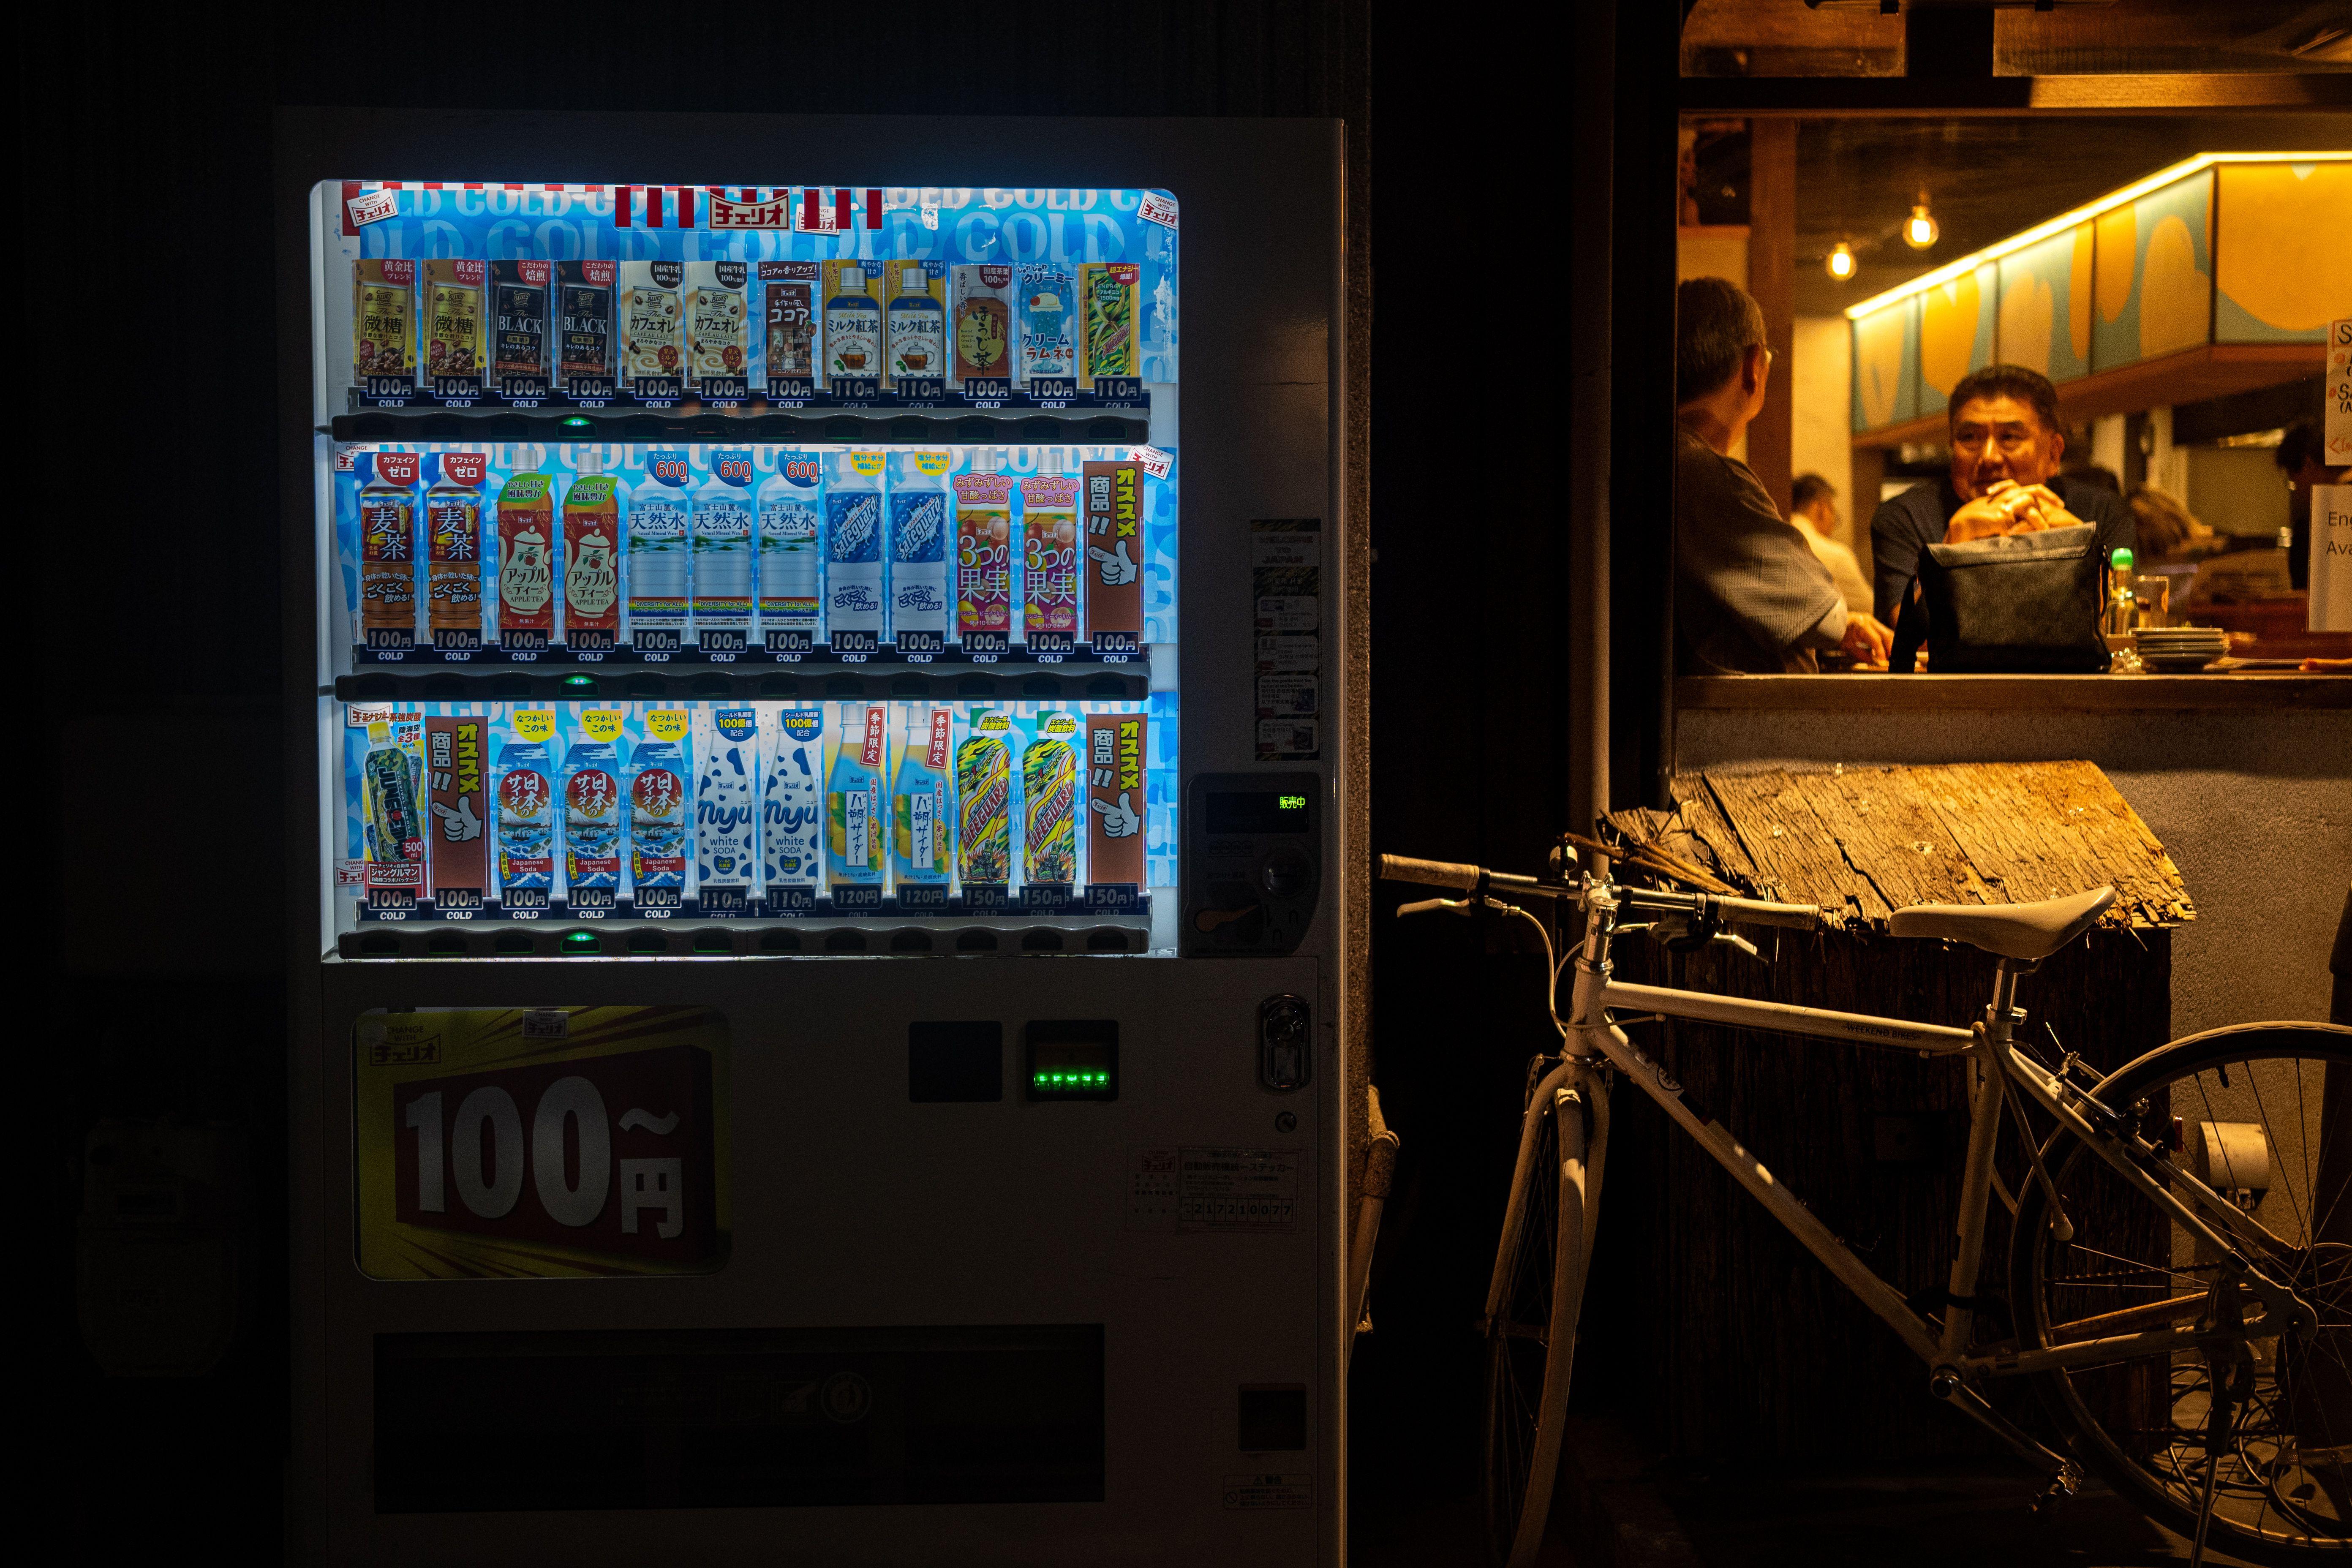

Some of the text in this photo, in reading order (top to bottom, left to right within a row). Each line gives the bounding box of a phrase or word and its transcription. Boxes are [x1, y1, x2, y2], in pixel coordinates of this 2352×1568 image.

[355, 202, 390, 221] チェリオ
[716, 201, 783, 225] チェリオ
[1144, 204, 1177, 224] チェリオ
[384, 261, 412, 272] 黄金比
[655, 265, 681, 274] 国産牛乳
[526, 271, 545, 281] 焙煎
[1024, 273, 1074, 284] クリーミー
[959, 272, 967, 318] 香ばしい香り
[363, 315, 402, 333] 微糖
[631, 316, 675, 333] カフェオレ
[769, 308, 809, 325] ココア
[498, 316, 542, 334] BLACK
[828, 320, 878, 333] ミルク紅茶
[972, 306, 993, 376] ほうじ茶
[1022, 334, 1070, 348] クリーム
[370, 379, 411, 395] 100円
[572, 380, 612, 396] 100円
[771, 381, 811, 396] 100円
[835, 381, 874, 397] 110円
[388, 467, 411, 478] ゼロ
[656, 461, 687, 478] 600
[508, 480, 544, 488] やさしい甘さ
[956, 477, 1010, 487] みずみずしい
[508, 489, 542, 498] 風味豊か
[961, 490, 1005, 501] 甘酸っぱさ
[639, 504, 677, 512] 富士山麓の
[1117, 468, 1136, 537] オススメ
[631, 512, 686, 530] 天然水
[845, 498, 869, 530] SPORTS DRINK
[370, 508, 407, 560] 麦茶
[834, 495, 877, 559] Safeguard
[959, 536, 1009, 569] 3つの
[365, 572, 411, 582] 身体が乾いた時に
[506, 567, 548, 584] アップル
[367, 582, 403, 598] ごくごく
[513, 584, 539, 596] ティー
[958, 566, 1009, 604] 果実
[384, 594, 410, 603] 飲める!
[371, 631, 411, 647] 100円
[571, 632, 611, 648] 100円
[901, 634, 940, 650] 100円
[1096, 634, 1135, 650] 100円
[973, 655, 998, 663] COLD
[517, 714, 553, 722] なつかしい
[719, 719, 752, 729] 100億個
[398, 724, 420, 734] 陸海空
[523, 724, 548, 732] この味
[980, 722, 1010, 731] 炭酸飲料
[397, 732, 420, 743] 全3種
[867, 711, 881, 762] 季節限定
[507, 775, 522, 814] サイダー
[520, 773, 543, 816] 日本の
[1280, 796, 1305, 809] 販売中
[698, 799, 752, 834] nyu
[959, 779, 1009, 852] LIFEGUARD
[848, 793, 864, 865] 八朔サイダー
[405, 843, 422, 852] 500
[710, 836, 738, 846] white
[371, 868, 418, 877] ジャングルマン
[506, 890, 545, 906] 100円
[839, 890, 877, 905] 120円
[965, 890, 1005, 906] 150円
[380, 912, 406, 920] COLD
[528, 1022, 563, 1034] チェリオ
[1847, 1024, 1916, 1040] WEEKEND BIKES
[374, 1043, 436, 1062] チェリオ
[1143, 1160, 1173, 1171] チェリオ
